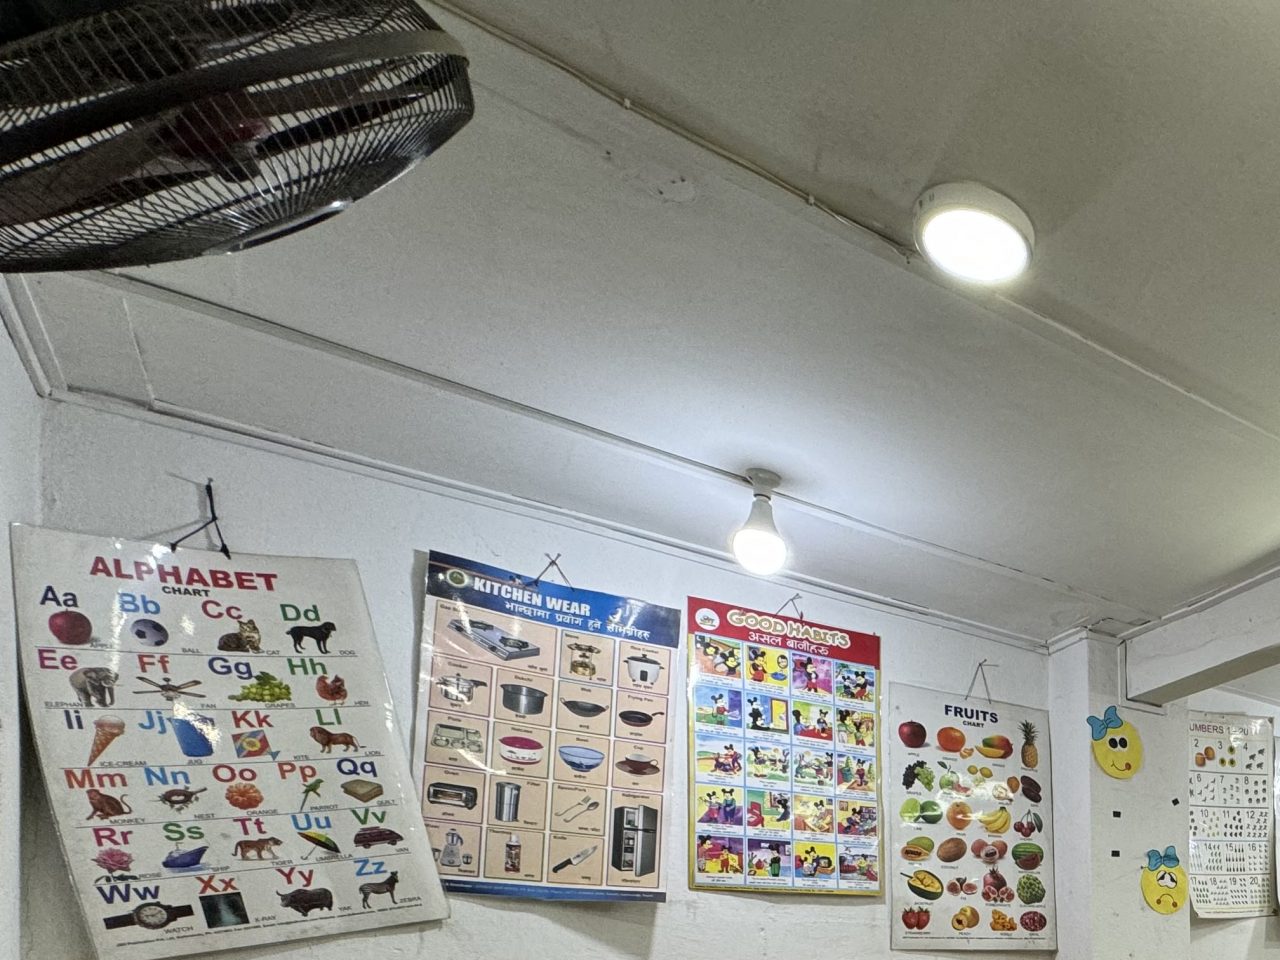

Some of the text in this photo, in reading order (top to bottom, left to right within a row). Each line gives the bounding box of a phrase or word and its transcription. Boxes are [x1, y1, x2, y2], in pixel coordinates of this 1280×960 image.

[90, 556, 278, 591] ALPHABET
[40, 585, 79, 608] Aa
[162, 586, 210, 597] CHART
[473, 577, 591, 617] KITCHEN WEAR
[119, 592, 160, 614] Bb
[201, 600, 243, 620] Cc
[280, 603, 320, 622] Dd
[555, 612, 583, 627] प्रयोग
[727, 609, 787, 635] GOOD
[787, 621, 850, 648] HABITS
[748, 631, 781, 646] असल
[38, 649, 78, 670] Ee
[137, 654, 170, 673] Ff
[208, 657, 253, 680] Gg
[287, 658, 327, 676] Hh
[64, 710, 83, 730] Ii
[139, 711, 166, 734] Jj
[232, 710, 273, 728] Kk
[945, 704, 998, 723] FRUITS
[962, 720, 985, 728] CHART
[1190, 723, 1224, 735] UMBERS
[1194, 739, 1199, 747] 2
[1218, 741, 1223, 749] 3
[1243, 742, 1248, 751] 4
[100, 760, 147, 768] ICE-CREAM
[277, 762, 317, 782] Pp
[337, 758, 378, 777] Qq
[64, 768, 128, 789] Mm
[144, 766, 191, 786] Nn
[212, 764, 257, 783] Oo
[1196, 774, 1201, 782] 6
[1219, 775, 1224, 784] 7
[1244, 776, 1249, 785] 8
[291, 813, 332, 831] Uu
[351, 808, 386, 825] Vv
[1200, 809, 1208, 818] 10
[1223, 810, 1230, 818] 11
[1246, 810, 1255, 819] 12
[163, 822, 204, 842] Ss
[233, 818, 267, 836] Tt
[93, 828, 133, 847] Rr
[1204, 843, 1212, 851] 14
[1226, 843, 1233, 851] 15
[1248, 843, 1256, 851] 16
[315, 853, 353, 862] UMBRELLA
[354, 858, 387, 876] Zz
[195, 875, 239, 895] Xx
[276, 867, 313, 887] Yy
[1190, 876, 1197, 885] 17
[1210, 877, 1217, 886] 18
[1229, 877, 1237, 886] 19
[1250, 876, 1258, 885] 20
[96, 884, 160, 904] Ww
[164, 926, 194, 934] WATCH
